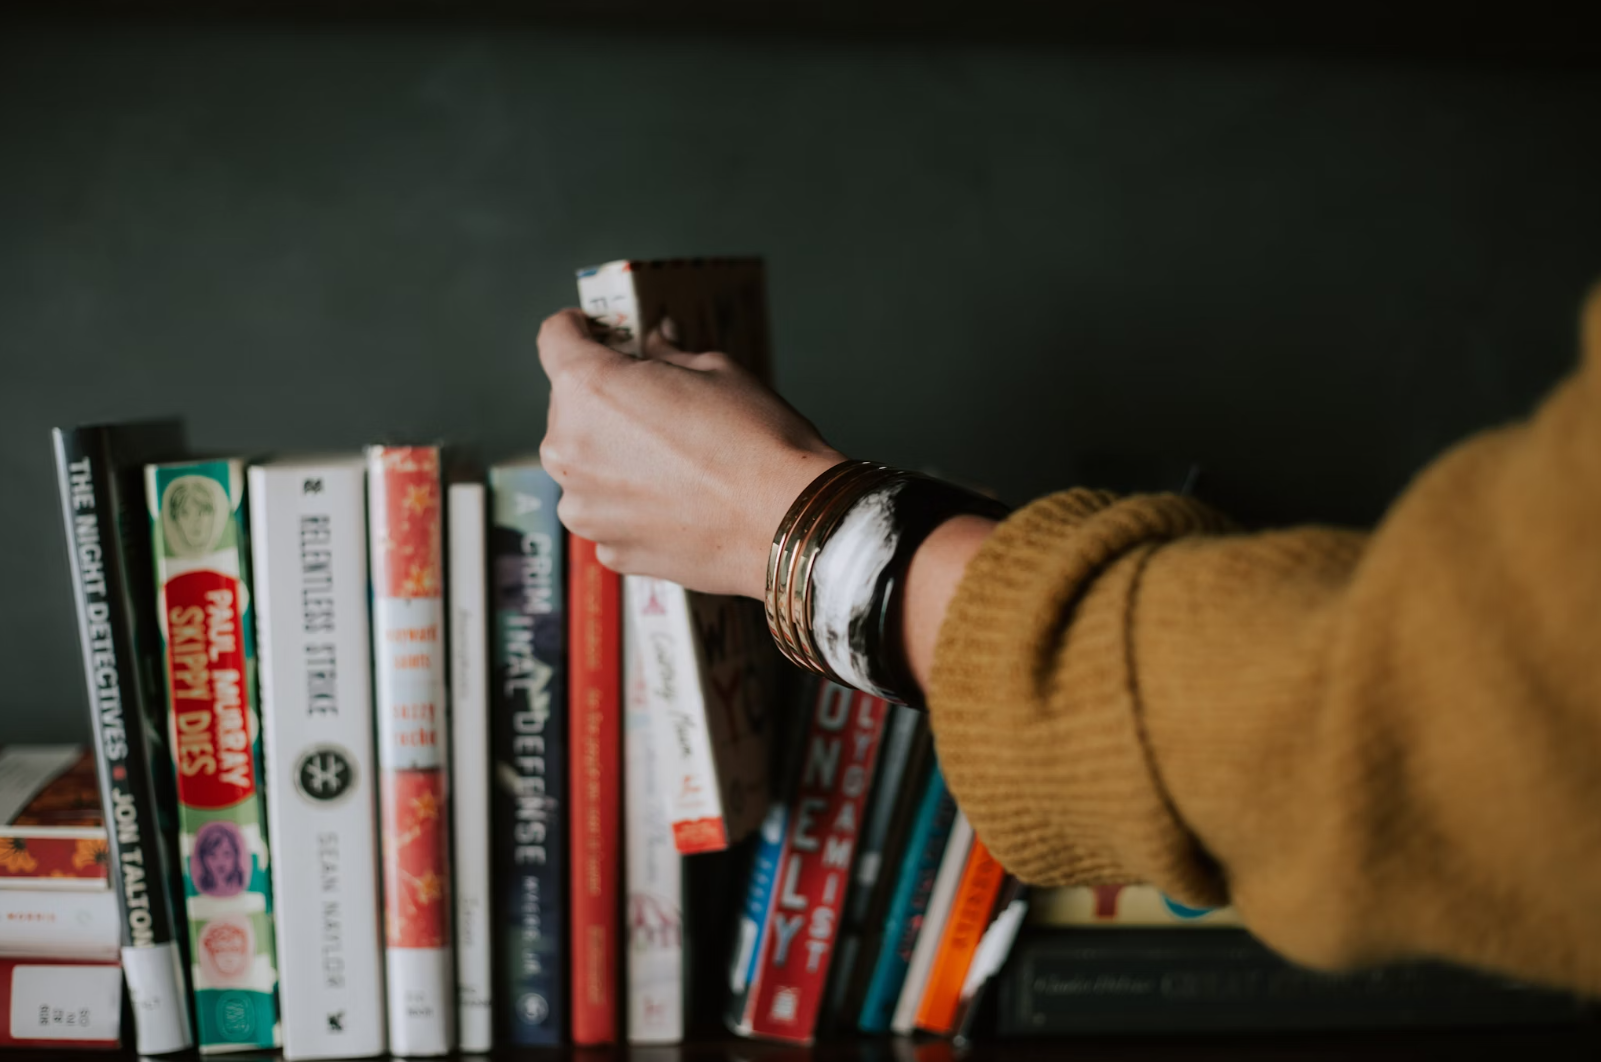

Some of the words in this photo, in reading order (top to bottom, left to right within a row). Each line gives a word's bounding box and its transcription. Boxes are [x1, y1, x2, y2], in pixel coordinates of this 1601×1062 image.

[69, 456, 93, 509] THE
[513, 491, 541, 515] A
[77, 513, 105, 597] NIGHT
[300, 513, 337, 638] RELENTLESS
[169, 604, 210, 700] SKIPPY
[203, 589, 235, 662] PAUL
[88, 602, 128, 763] DETECTIVES
[304, 641, 339, 717] STRIKE
[177, 710, 216, 777] DIES
[212, 671, 251, 790] MURRAY
[112, 788, 138, 841] JON
[512, 711, 549, 865] DEFENSE
[772, 680, 853, 968] ONELY
[315, 832, 340, 894] SEAN
[806, 695, 876, 972] LYGAMIST
[318, 900, 346, 990] NAYLOR
